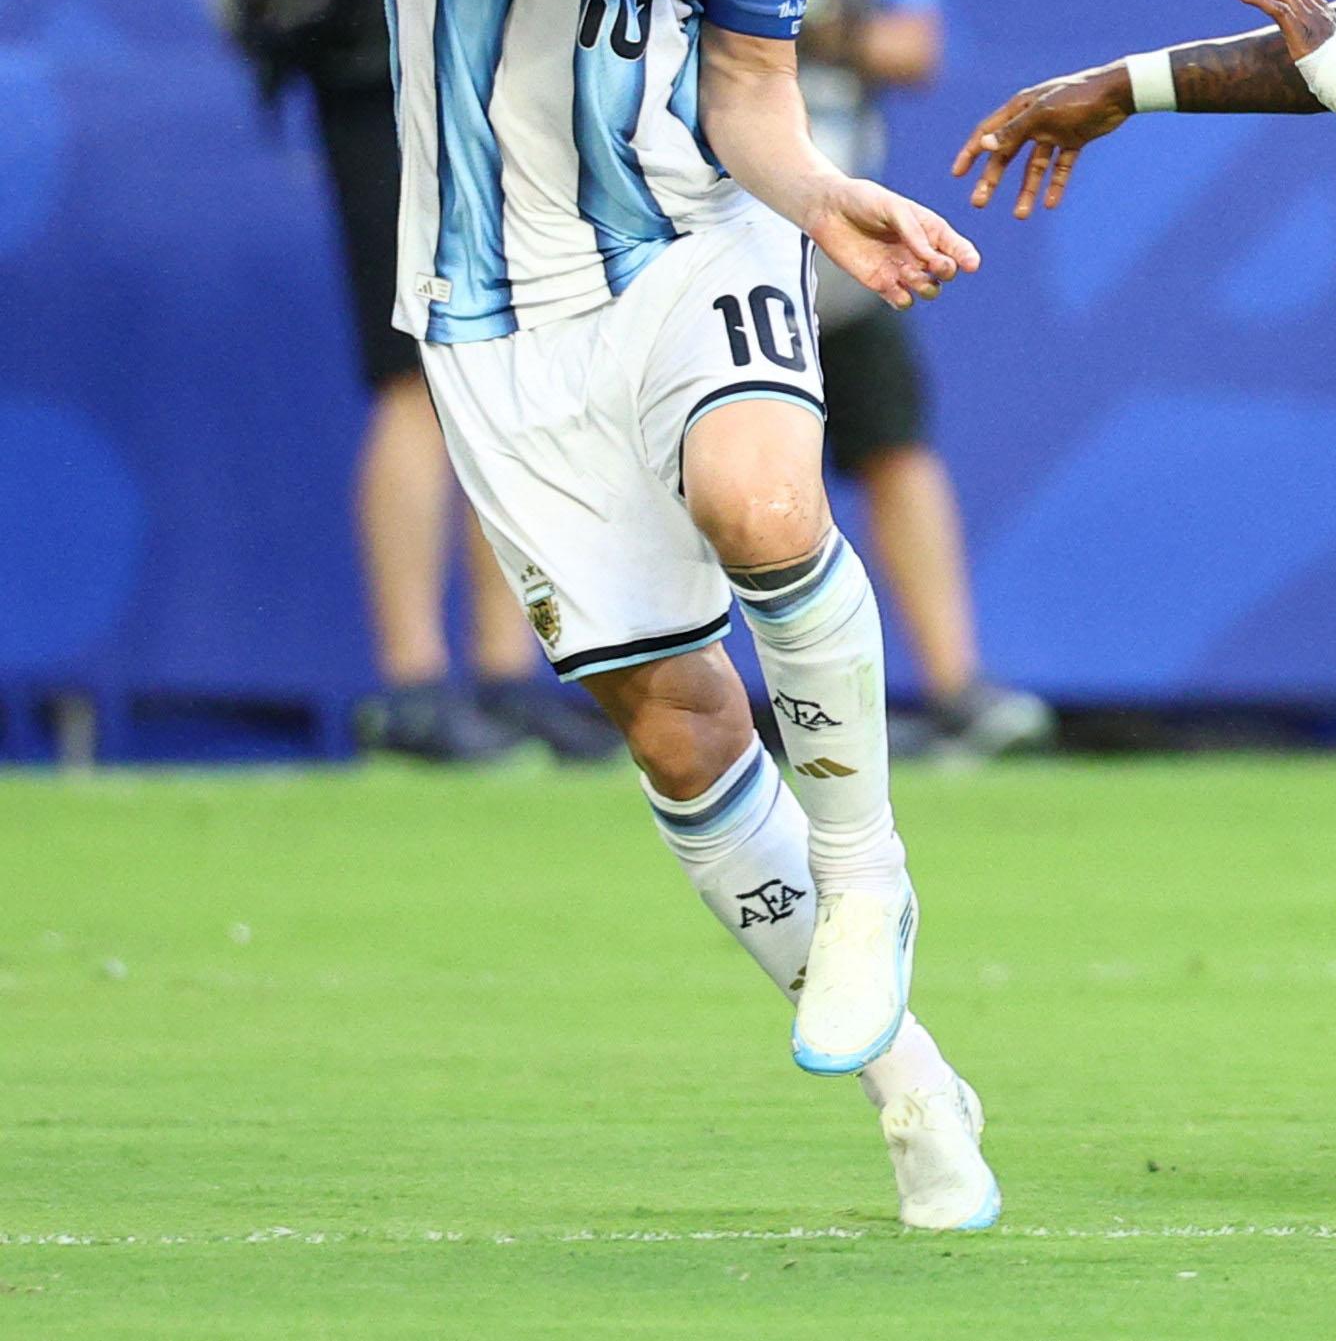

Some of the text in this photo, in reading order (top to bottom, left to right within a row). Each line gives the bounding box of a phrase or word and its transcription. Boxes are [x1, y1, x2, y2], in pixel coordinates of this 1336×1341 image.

[713, 284, 807, 373] 10
[773, 688, 843, 731] AFA
[735, 878, 807, 929] AFA
